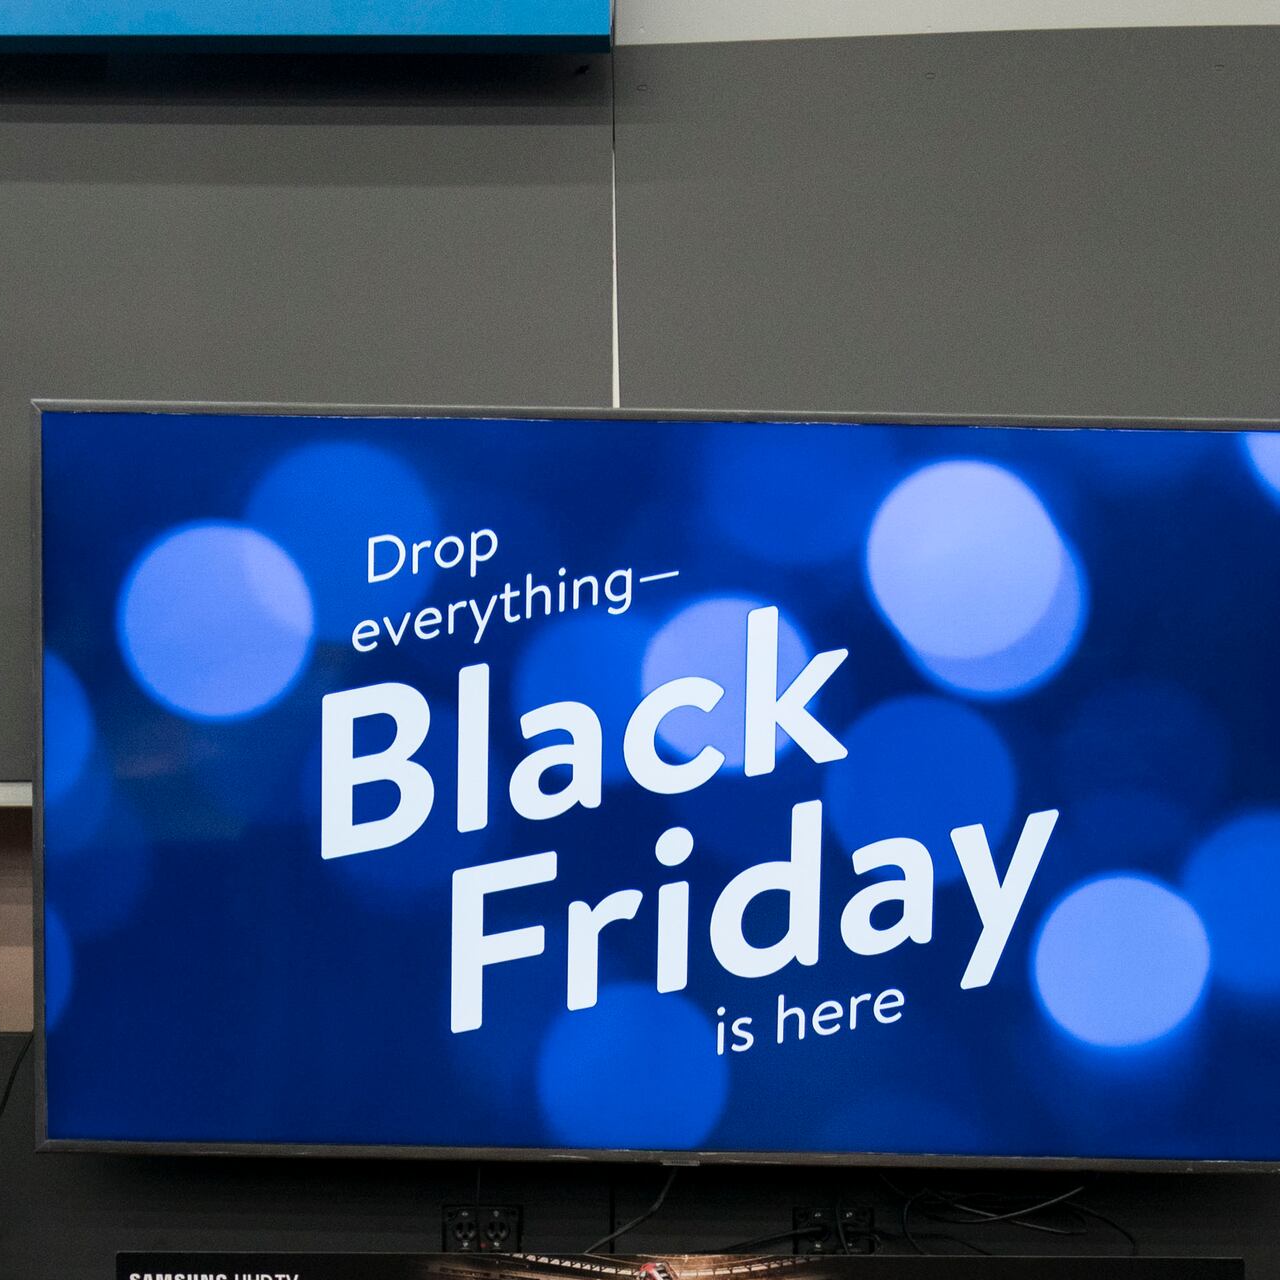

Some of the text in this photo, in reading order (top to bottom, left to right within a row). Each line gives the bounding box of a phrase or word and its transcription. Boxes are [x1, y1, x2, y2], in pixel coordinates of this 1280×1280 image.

[368, 529, 498, 583] Drop
[321, 606, 850, 861] Black
[450, 799, 1060, 1034] Friday
[716, 989, 905, 1055] is here
